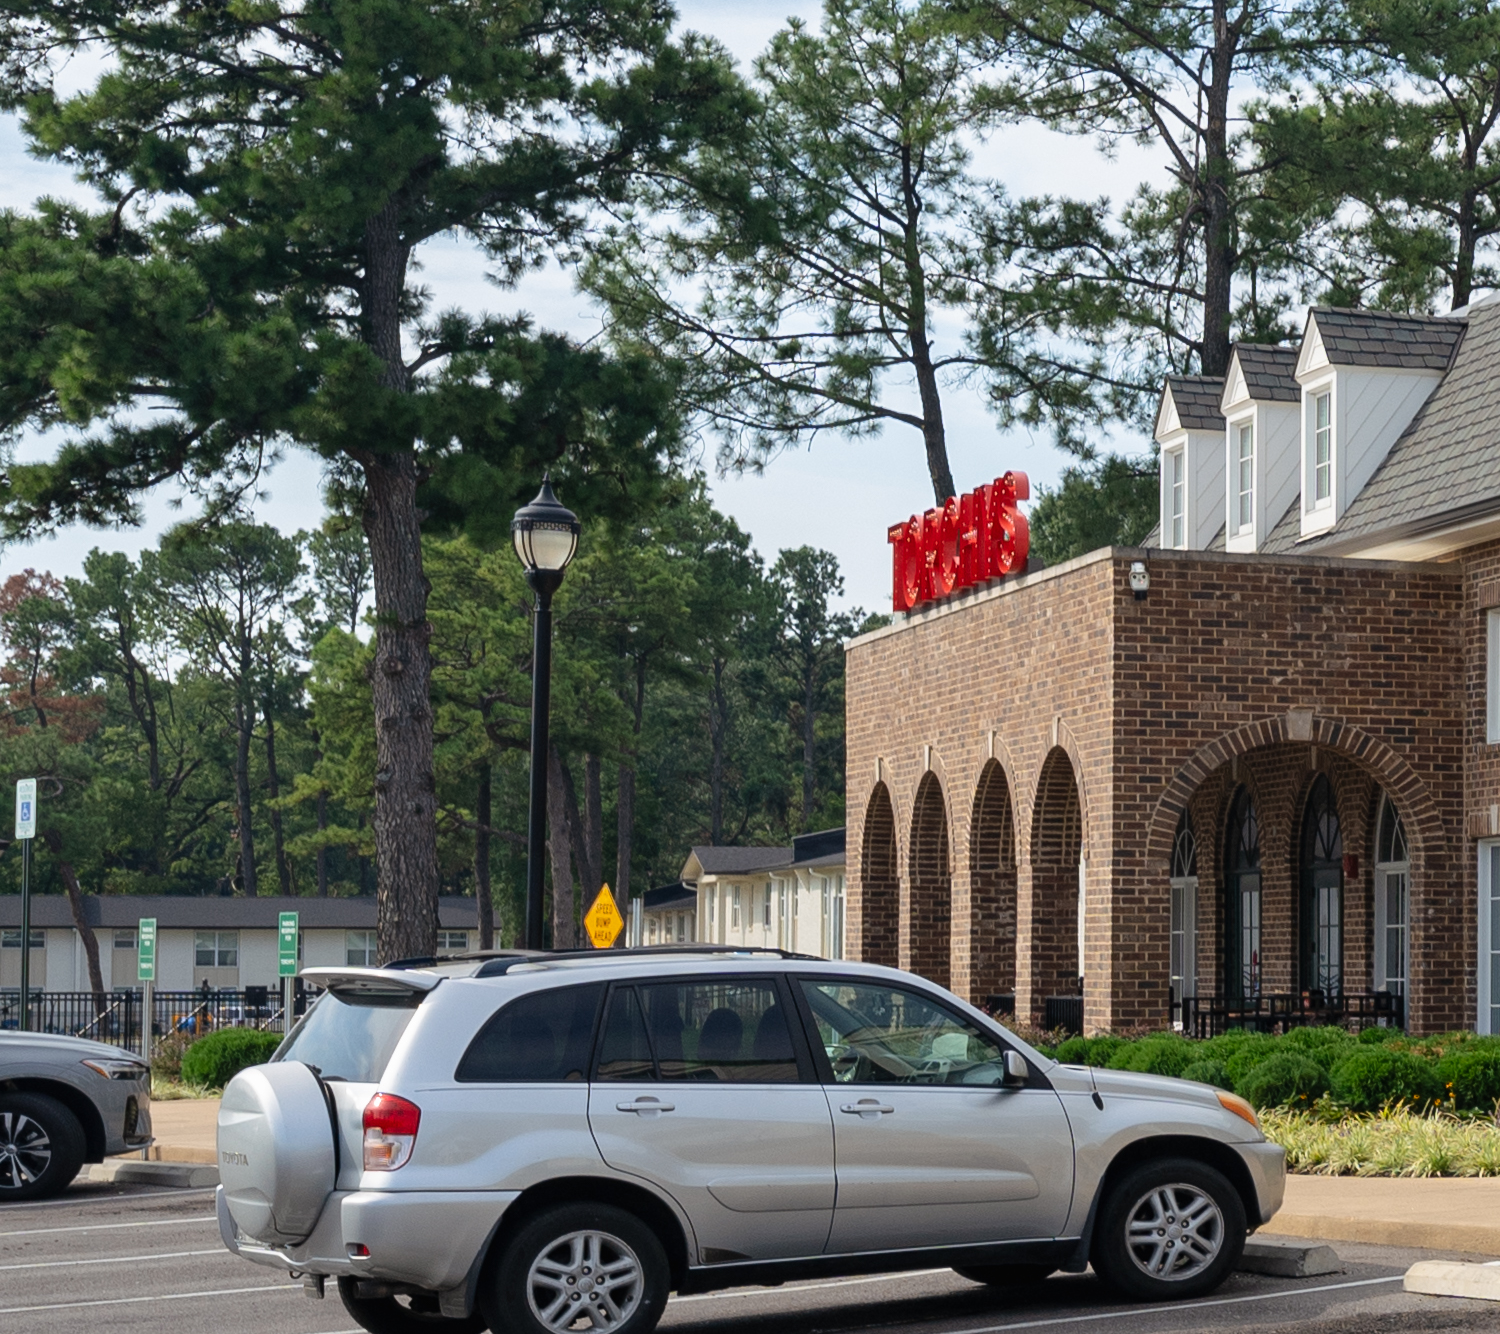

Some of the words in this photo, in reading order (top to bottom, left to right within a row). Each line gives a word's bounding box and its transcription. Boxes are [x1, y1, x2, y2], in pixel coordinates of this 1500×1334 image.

[596, 903, 613, 915] SPEED
[596, 918, 611, 928] BUMP
[594, 930, 612, 942] AHEAD
[222, 1151, 249, 1166] TOYOTA
